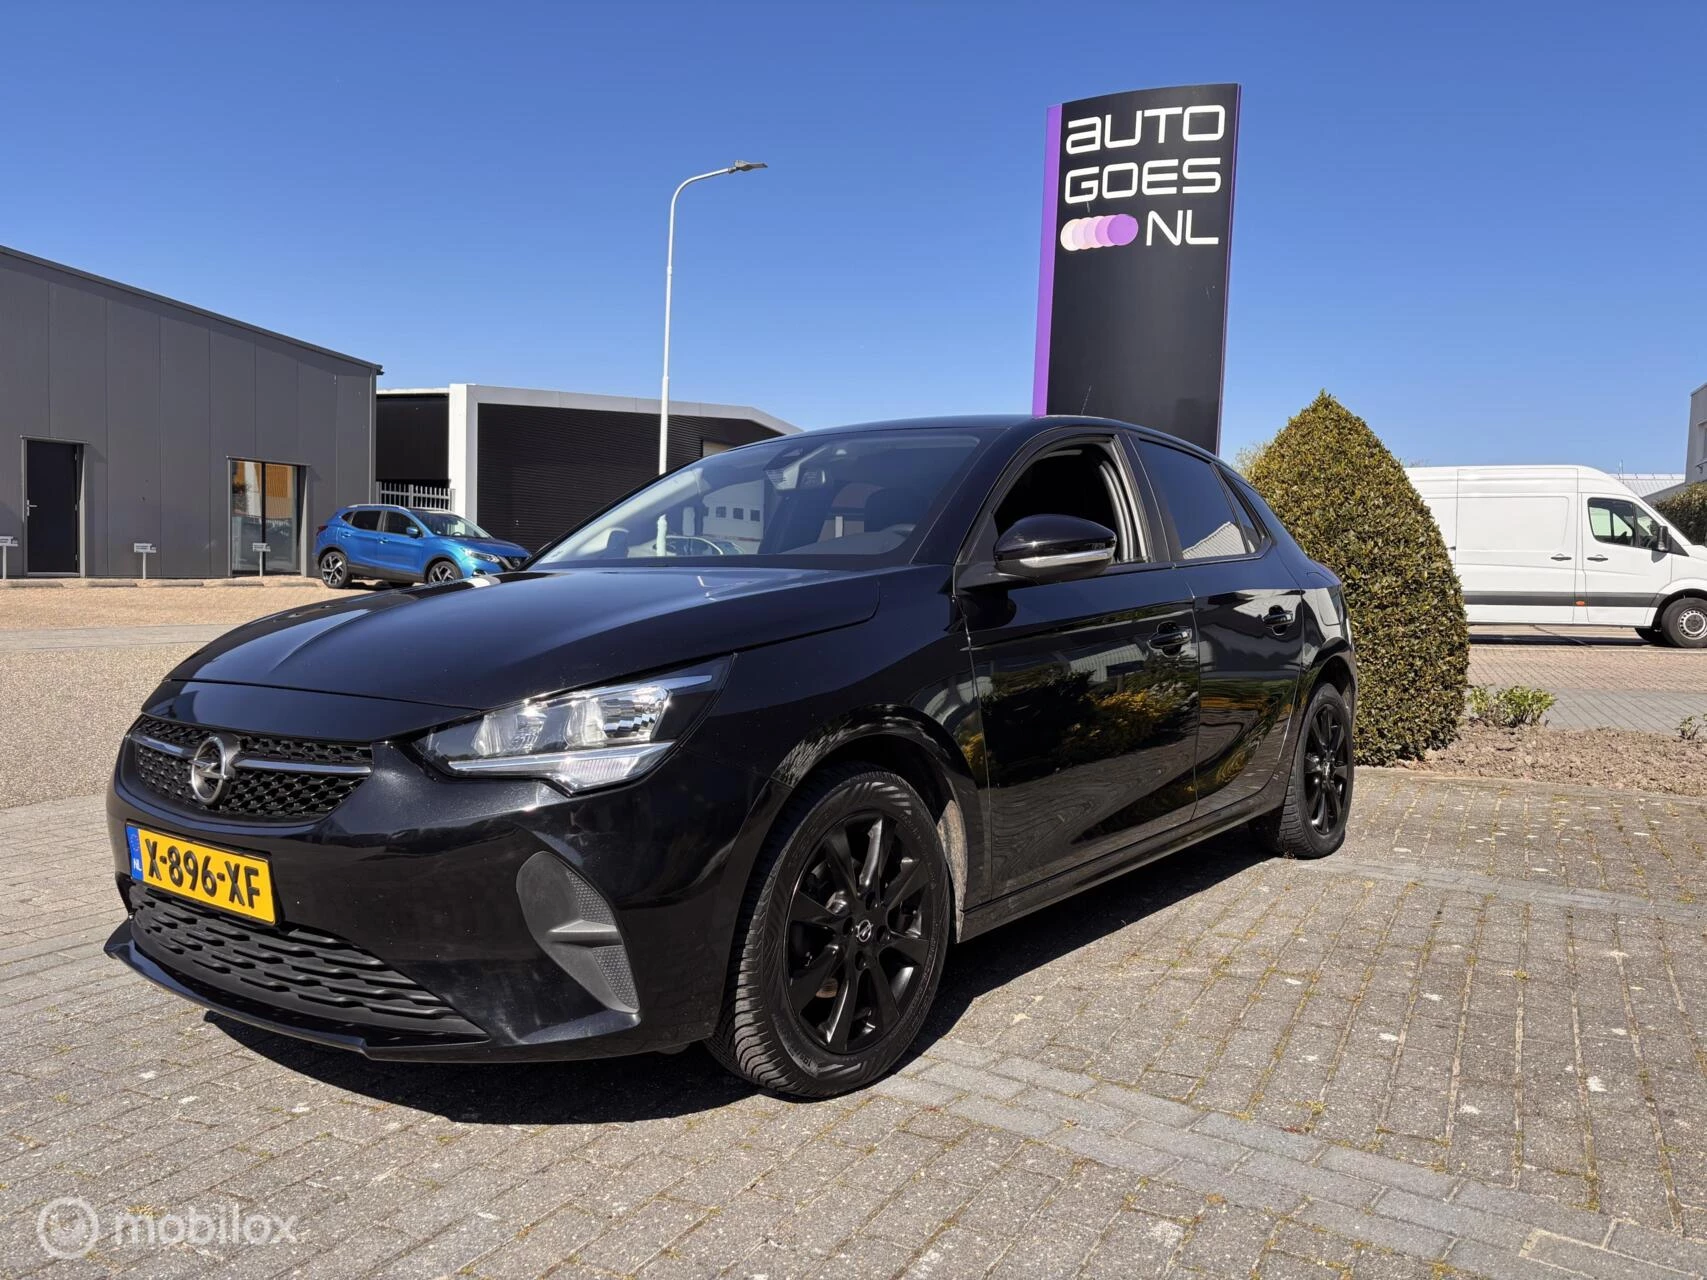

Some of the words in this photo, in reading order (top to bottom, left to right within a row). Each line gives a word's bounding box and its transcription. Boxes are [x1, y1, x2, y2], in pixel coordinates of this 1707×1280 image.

[1064, 157, 1222, 205] GOES
[1146, 209, 1219, 247] NL
[145, 838, 261, 909] X-896-XF
